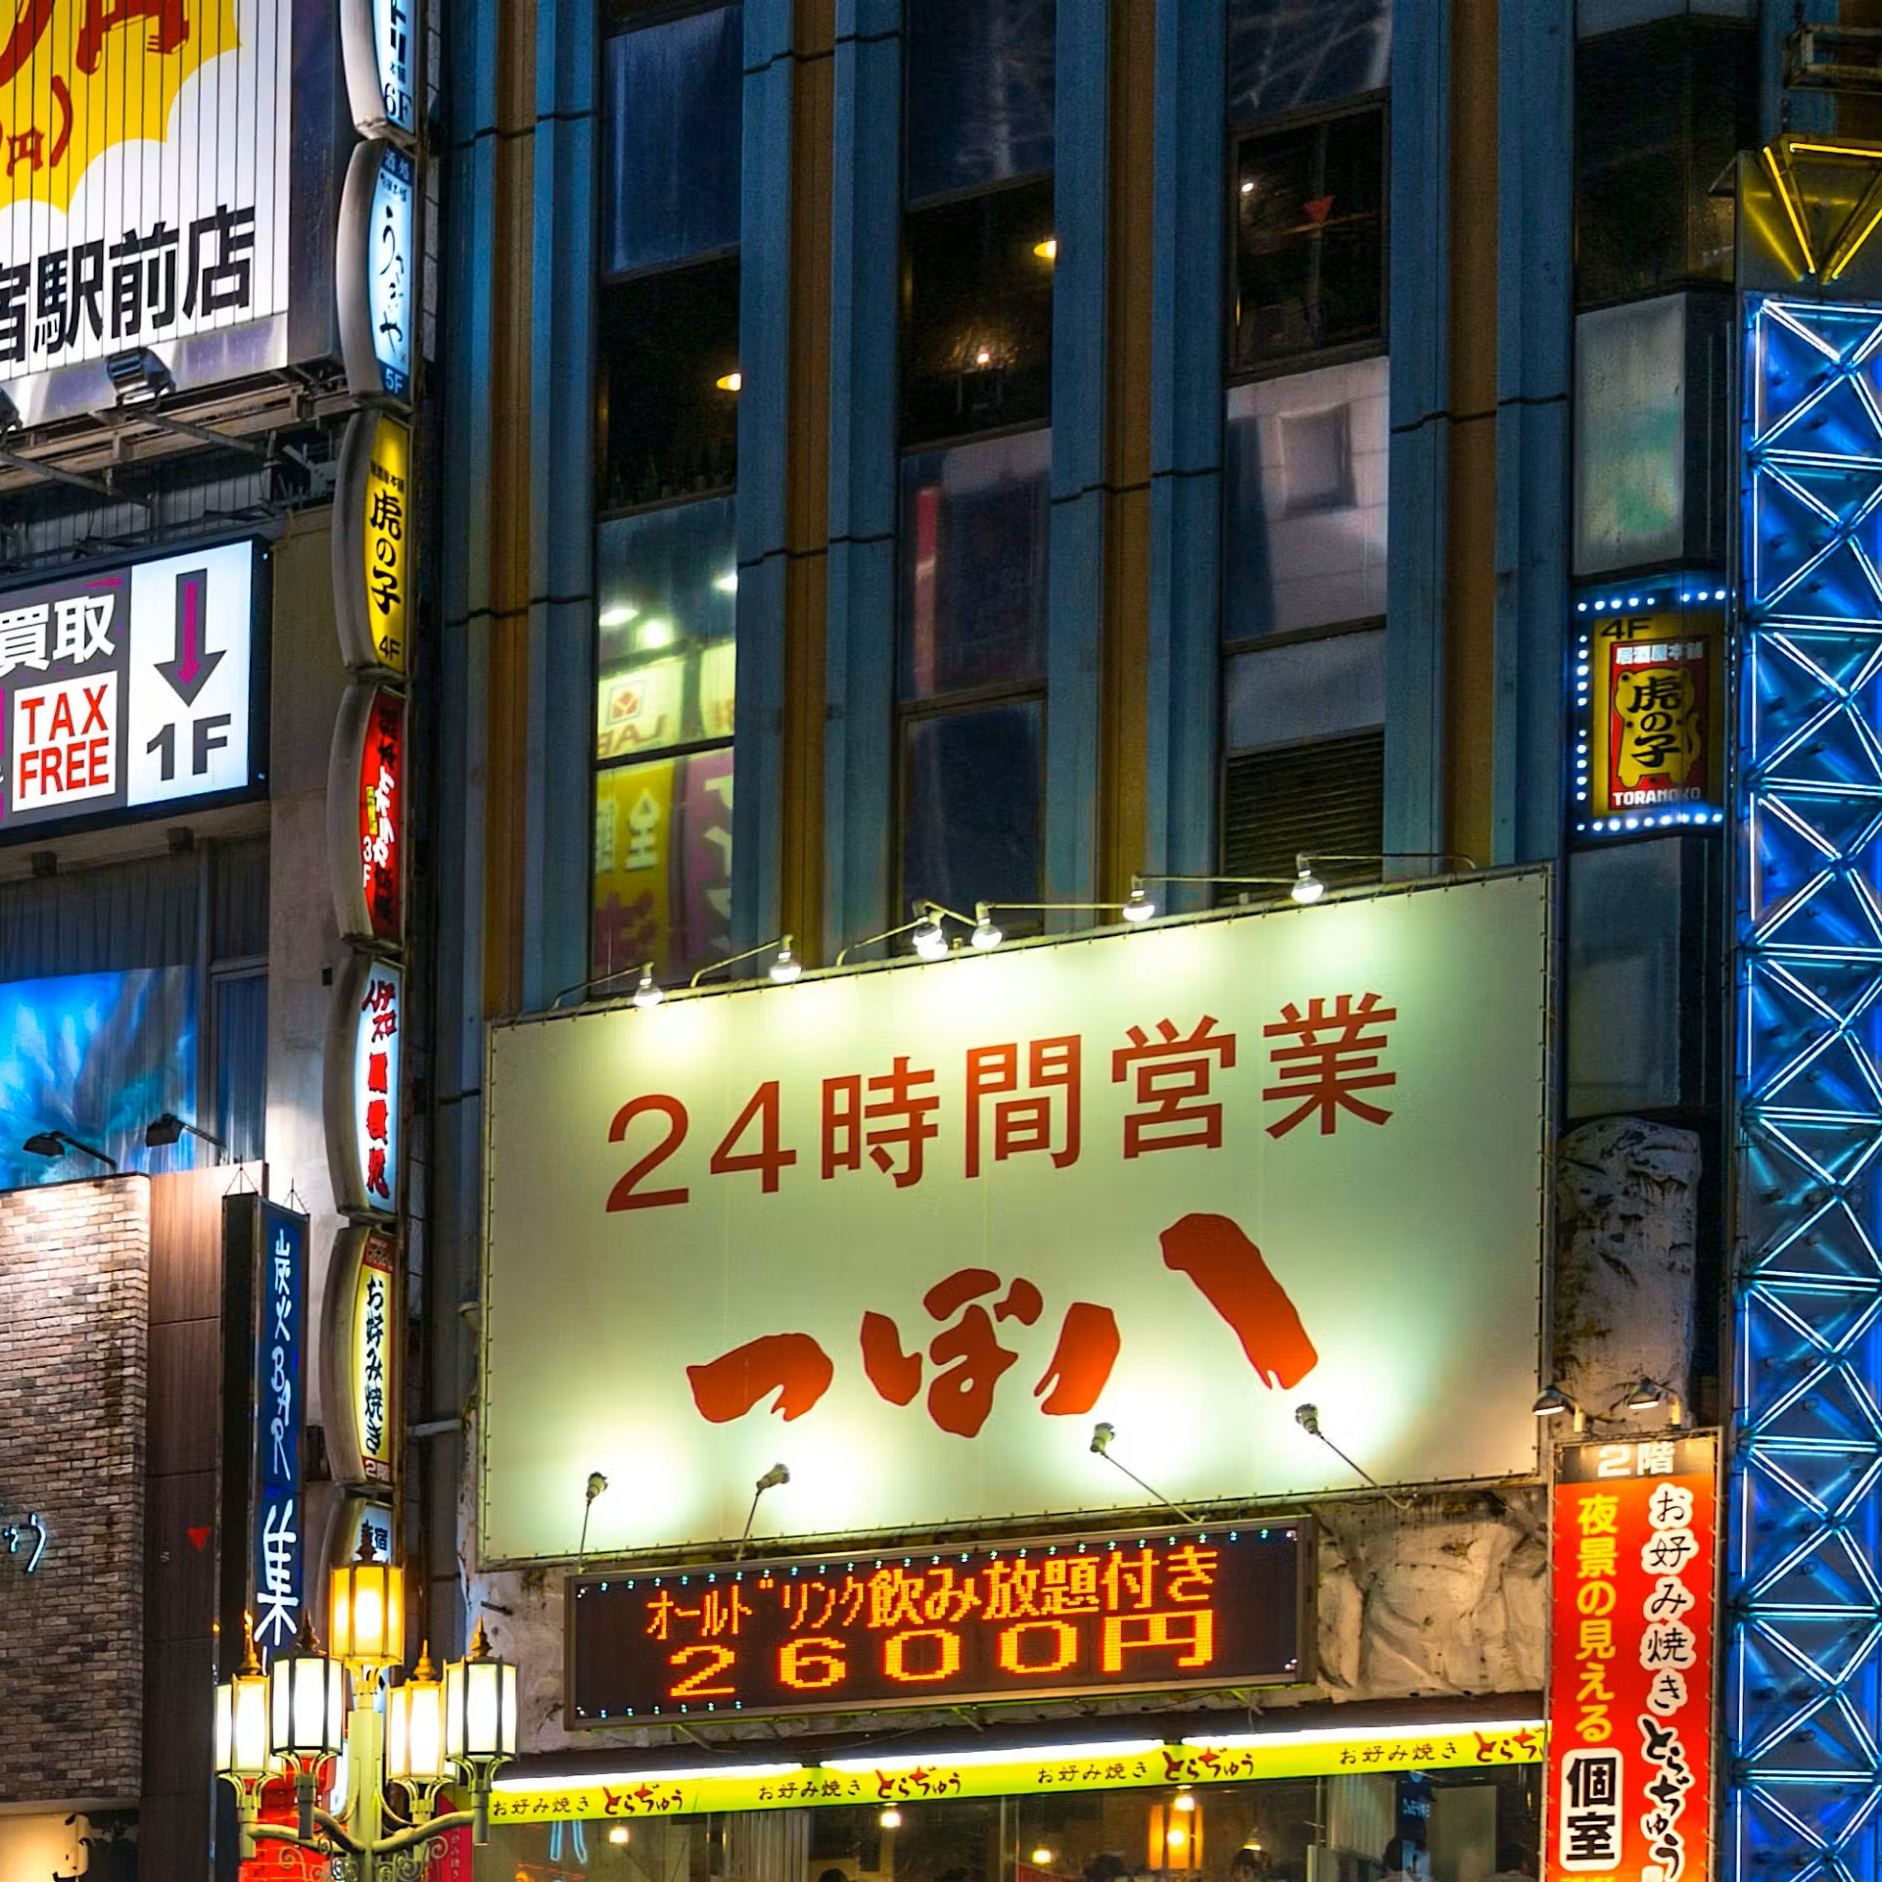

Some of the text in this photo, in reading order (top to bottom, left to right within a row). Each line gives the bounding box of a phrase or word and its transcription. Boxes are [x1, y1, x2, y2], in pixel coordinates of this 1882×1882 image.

[385, 83, 413, 122] 6F
[384, 367, 405, 391] 5F
[371, 492, 403, 617] 虎の子
[378, 638, 401, 661] 4F
[19, 683, 111, 743] TAX
[144, 715, 233, 783] 1F
[1626, 675, 1684, 769] 虎の子
[19, 737, 111, 803] FREE
[1613, 786, 1703, 808] TORANOKO
[604, 990, 1400, 1214] 24時間営業
[269, 1227, 292, 1482] 炭火BAR
[366, 1274, 385, 1455] お好み焼き
[685, 1212, 1321, 1439] つぼ八
[365, 1461, 392, 1482] 2階
[1595, 1442, 1675, 1476] 2階
[666, 1608, 1214, 1700] 2600円
[1574, 1493, 1620, 1743] 夜景の見える
[1642, 1489, 1695, 1882] お好み焼き とらぢゅう
[1564, 1755, 1617, 1862] 個室
